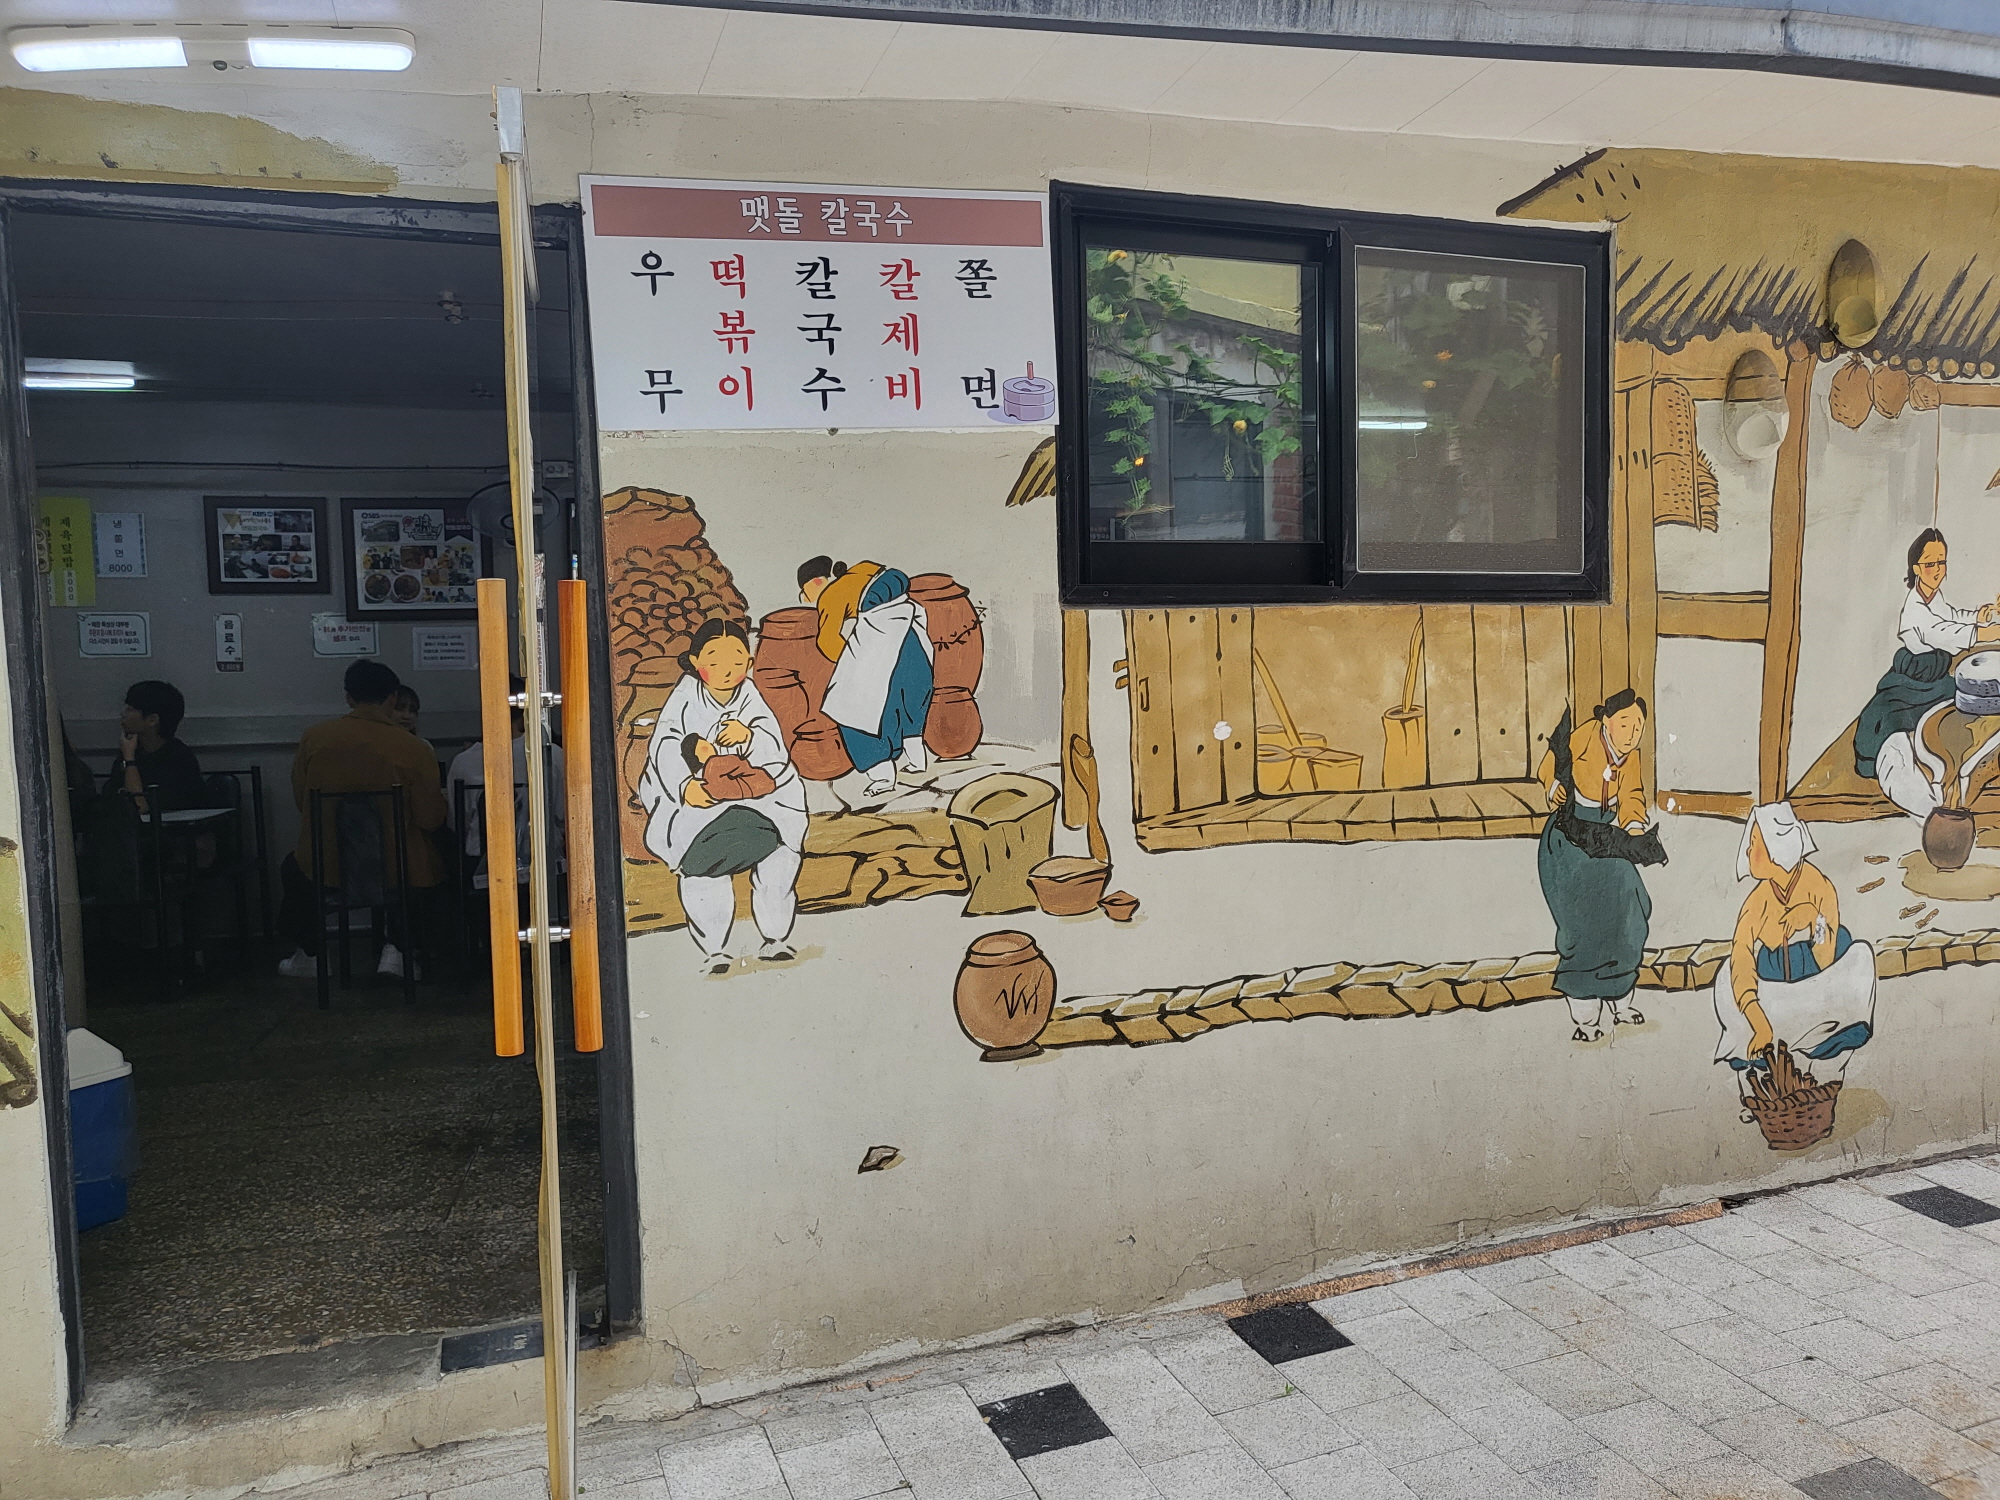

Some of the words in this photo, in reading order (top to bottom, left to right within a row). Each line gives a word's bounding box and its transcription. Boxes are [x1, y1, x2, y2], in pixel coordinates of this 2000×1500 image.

[739, 195, 804, 234] 맷돌
[821, 198, 913, 237] 칼국수
[630, 250, 684, 414] 우무
[709, 253, 755, 411] 떡볶이
[796, 256, 846, 411] 칼국수
[879, 258, 921, 411] 칼제비
[954, 258, 1000, 409] 쫄면
[108, 564, 132, 573] 8000
[224, 620, 236, 655] 음료수
